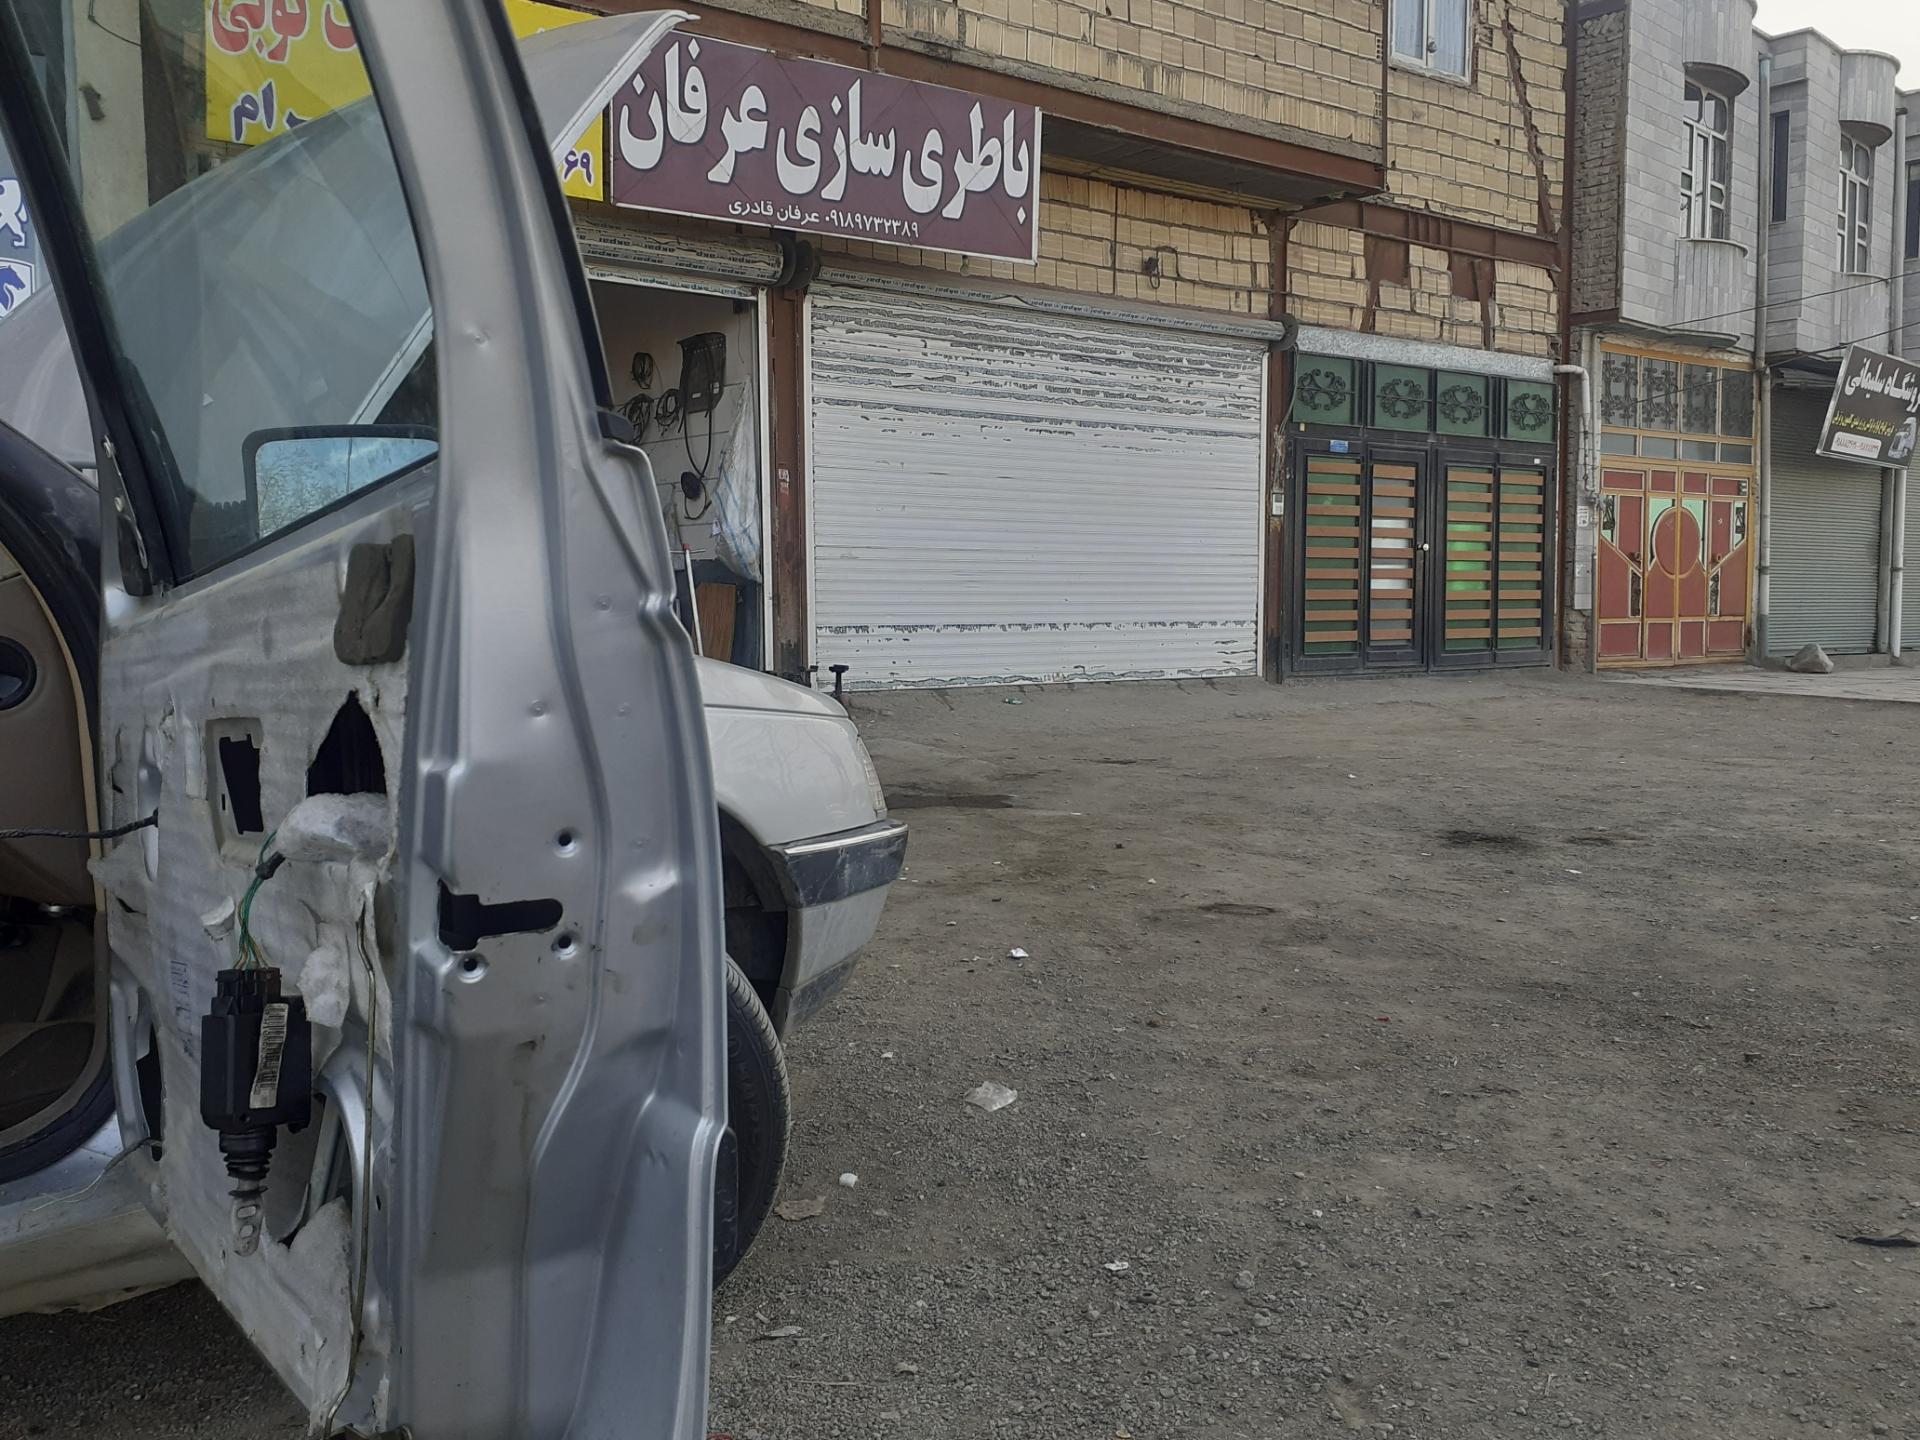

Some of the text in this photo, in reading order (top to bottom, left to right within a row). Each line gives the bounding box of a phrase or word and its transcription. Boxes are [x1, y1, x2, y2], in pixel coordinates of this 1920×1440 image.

[619, 38, 1030, 225] باطری سازی عرفان
[728, 200, 774, 216] قادری
[777, 204, 820, 225] عرفان
[1844, 357, 1920, 413] روشگاه سلیمانی
